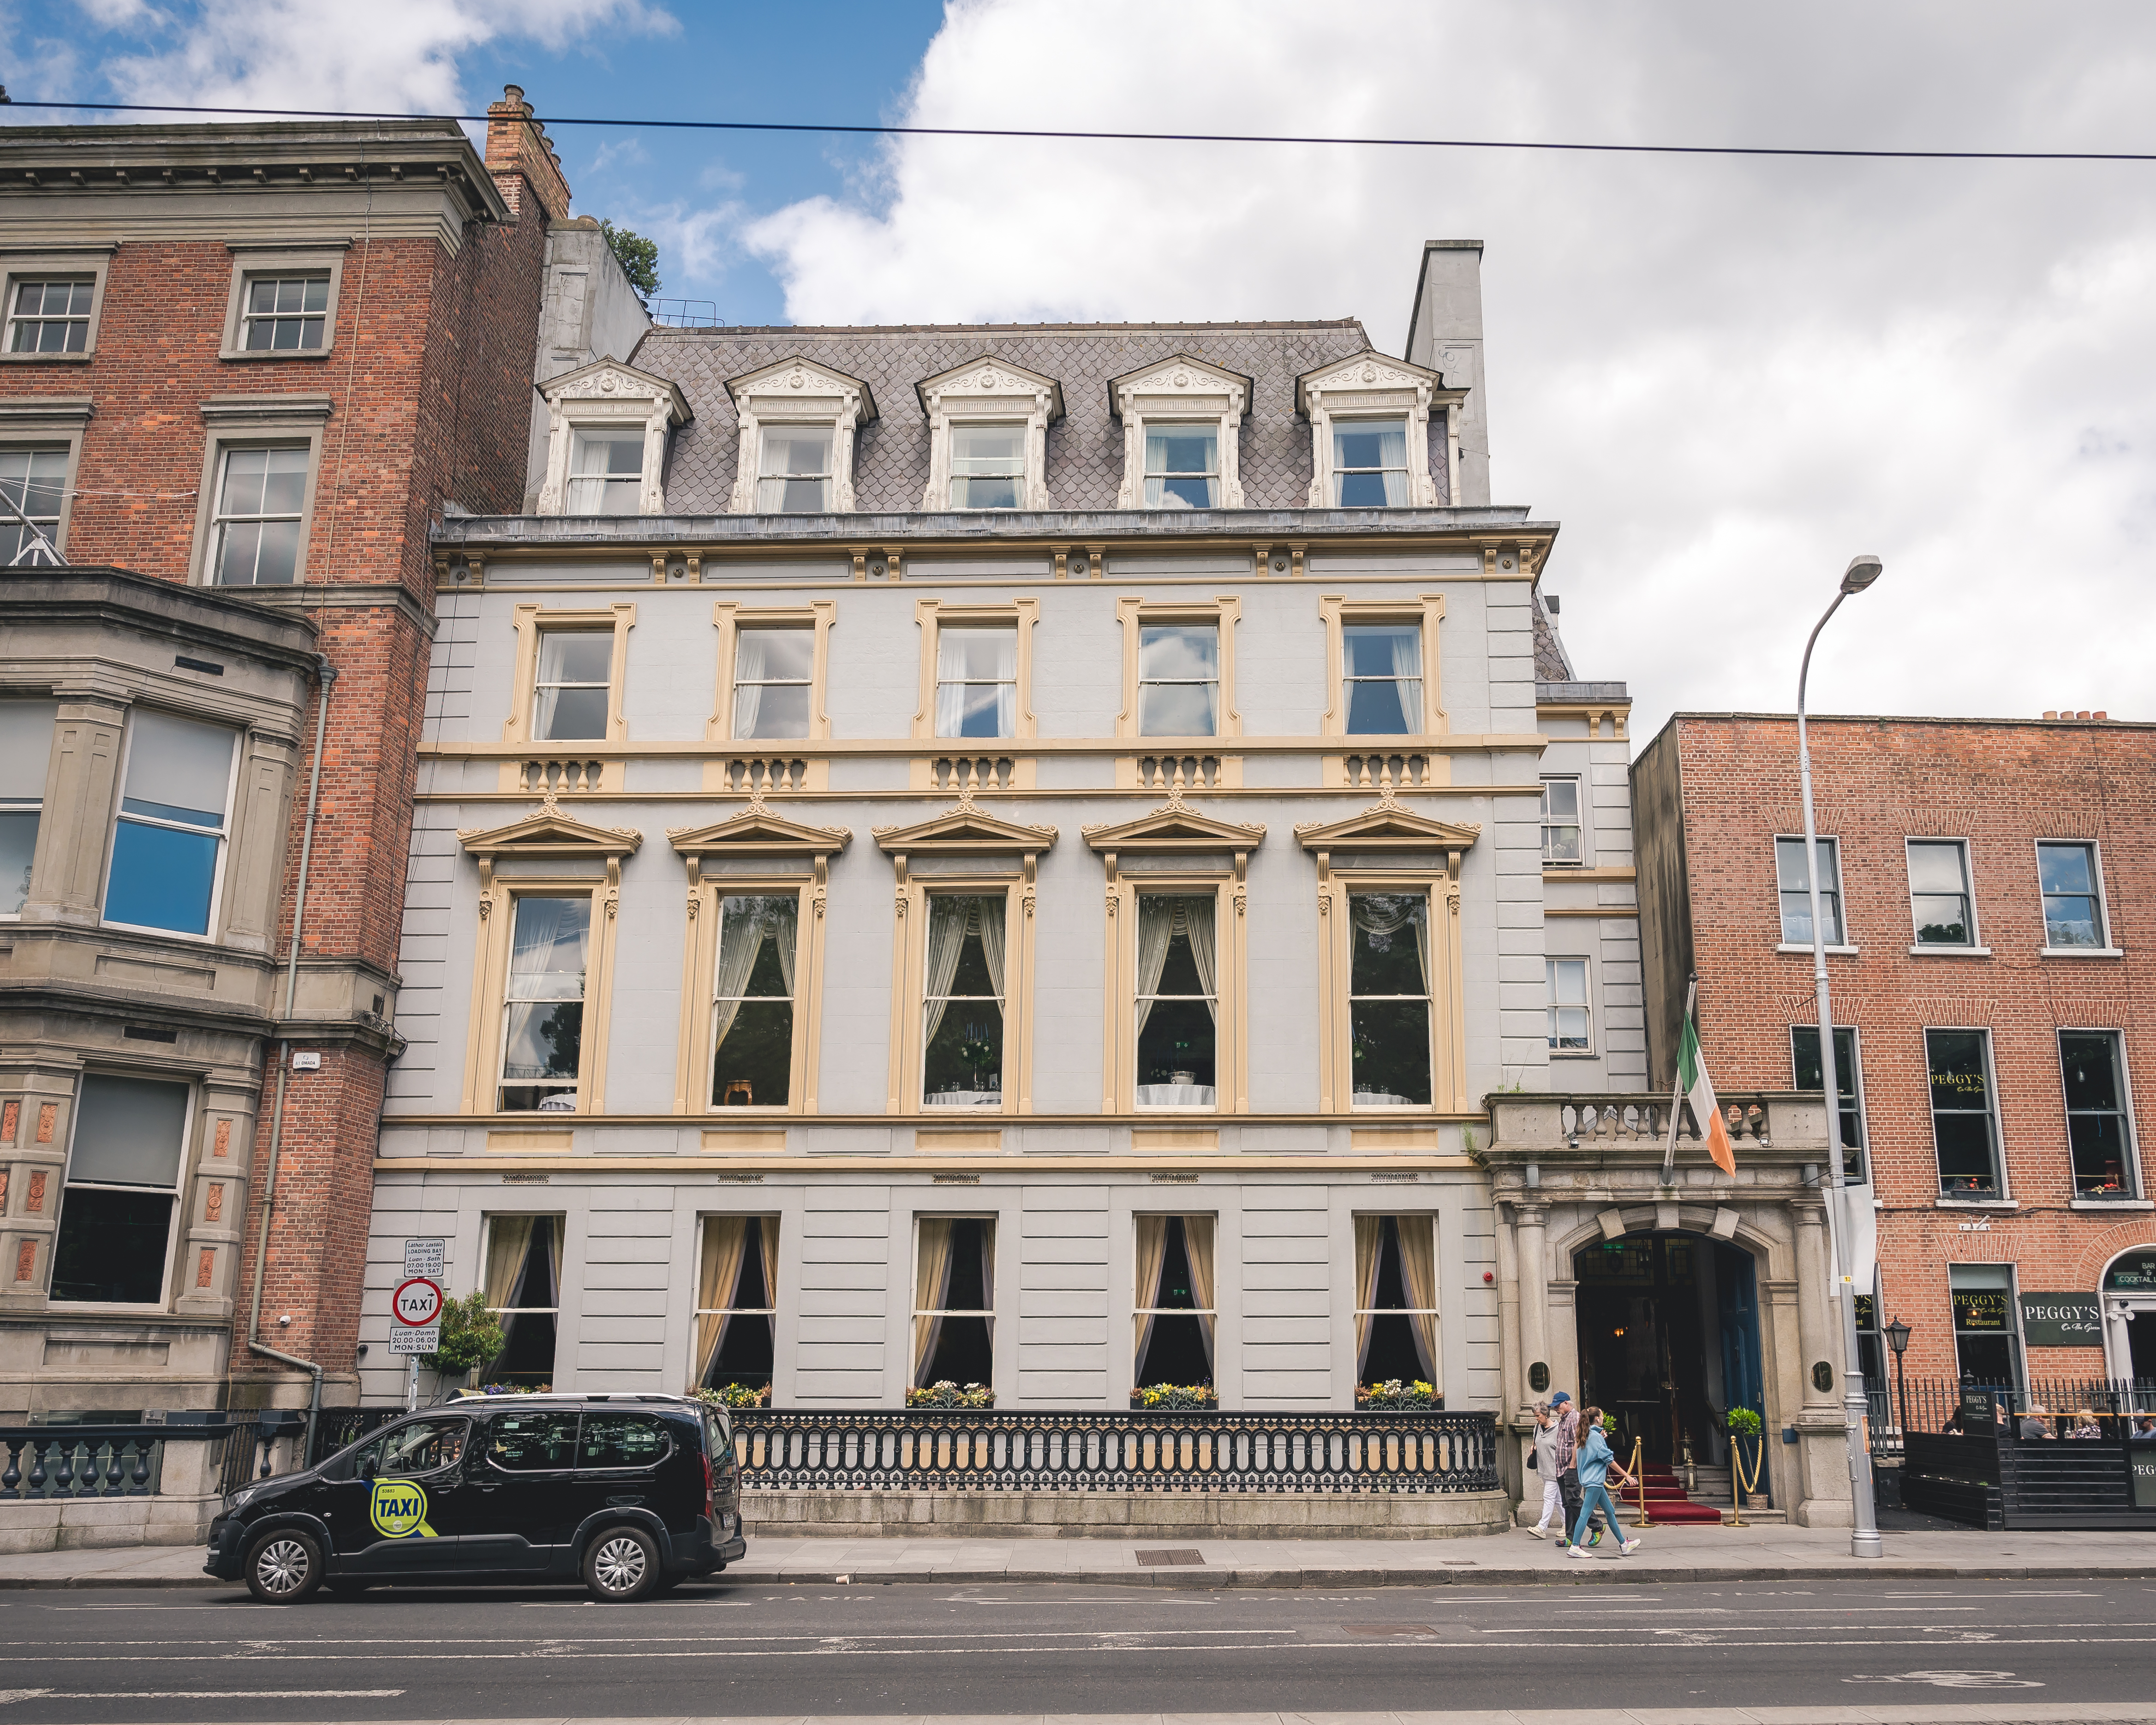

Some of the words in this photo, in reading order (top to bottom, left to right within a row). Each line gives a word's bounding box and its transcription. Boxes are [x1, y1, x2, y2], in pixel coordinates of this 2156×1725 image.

[1931, 1074, 1984, 1084] PEGGY'S
[401, 1299, 432, 1311] TAXI
[1953, 1295, 2008, 1305] PEGGY'S
[2025, 1306, 2099, 1319] PEGGY'S
[2061, 1323, 2071, 1331] On
[2084, 1323, 2100, 1333] Green
[1966, 1395, 1987, 1404] PEGGY'S
[2132, 1465, 2156, 1475] PEG
[378, 1498, 419, 1517] TAXI
